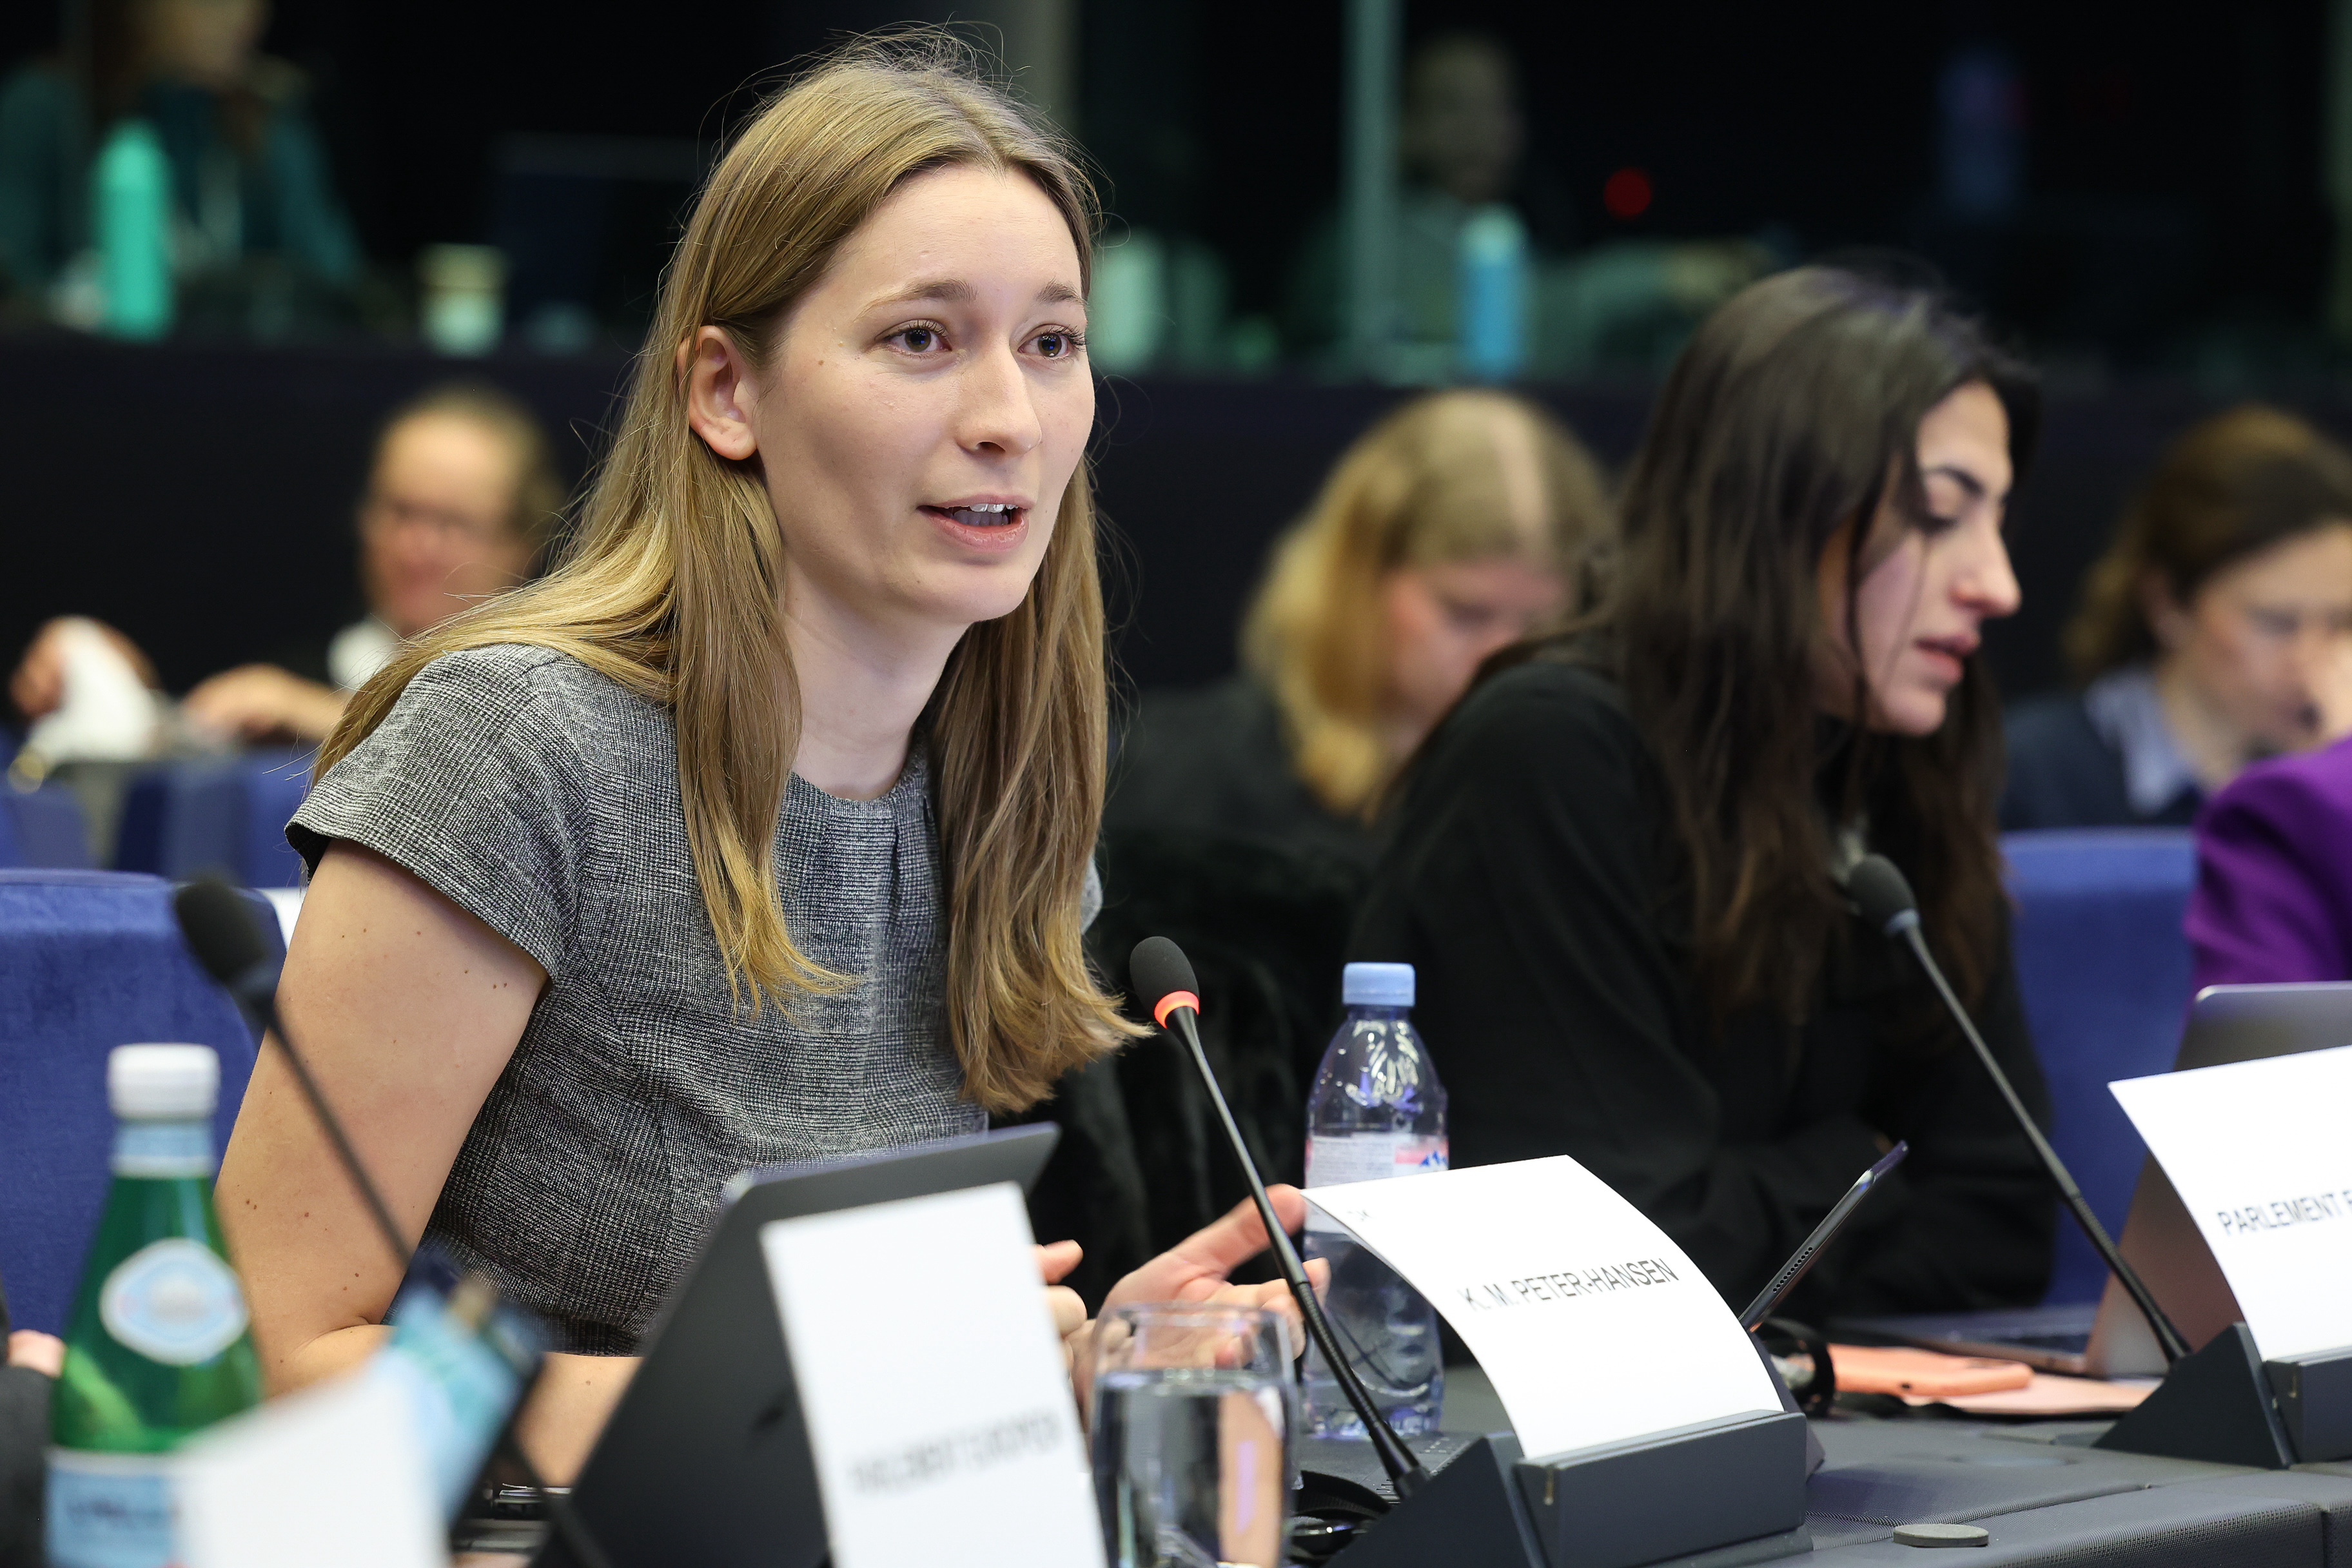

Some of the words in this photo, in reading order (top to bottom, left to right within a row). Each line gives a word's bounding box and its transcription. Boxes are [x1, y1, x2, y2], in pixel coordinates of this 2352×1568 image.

[2218, 1193, 2342, 1235] PARLEMENT
[1457, 1288, 1491, 1311] K.
[1483, 1283, 1518, 1308] M.
[1511, 1258, 1680, 1302] PETER-HANSEN
